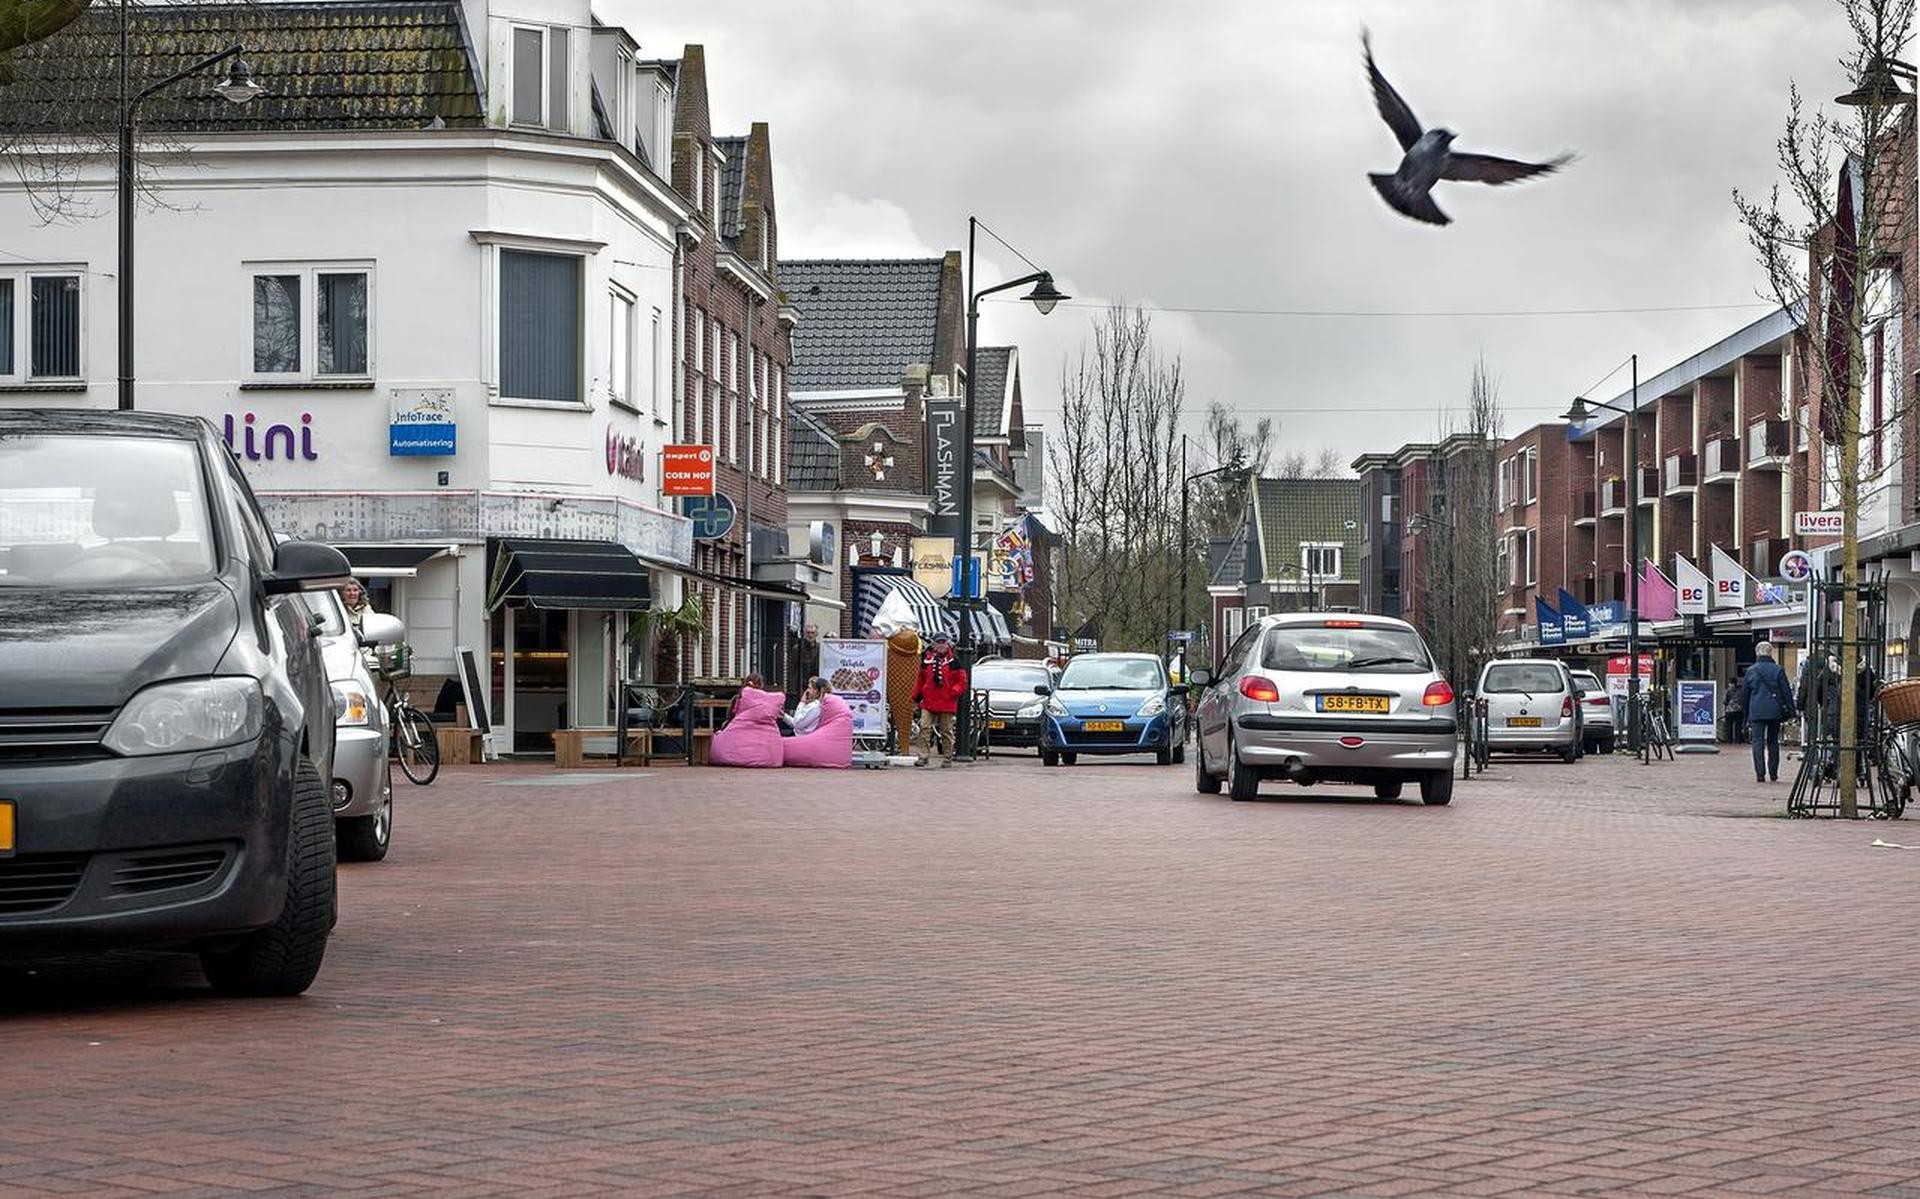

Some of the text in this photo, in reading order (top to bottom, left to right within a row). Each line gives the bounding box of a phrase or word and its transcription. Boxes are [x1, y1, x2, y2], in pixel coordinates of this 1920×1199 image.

[396, 411, 443, 421] InfoTrace
[392, 439, 454, 448] Automatisering
[666, 452, 697, 460] expert
[932, 410, 960, 517] FLASHMAN
[1800, 513, 1842, 527] livera
[1719, 580, 1740, 592] BC
[1682, 589, 1703, 600] BC
[1328, 697, 1383, 709] 58-FB-TX
